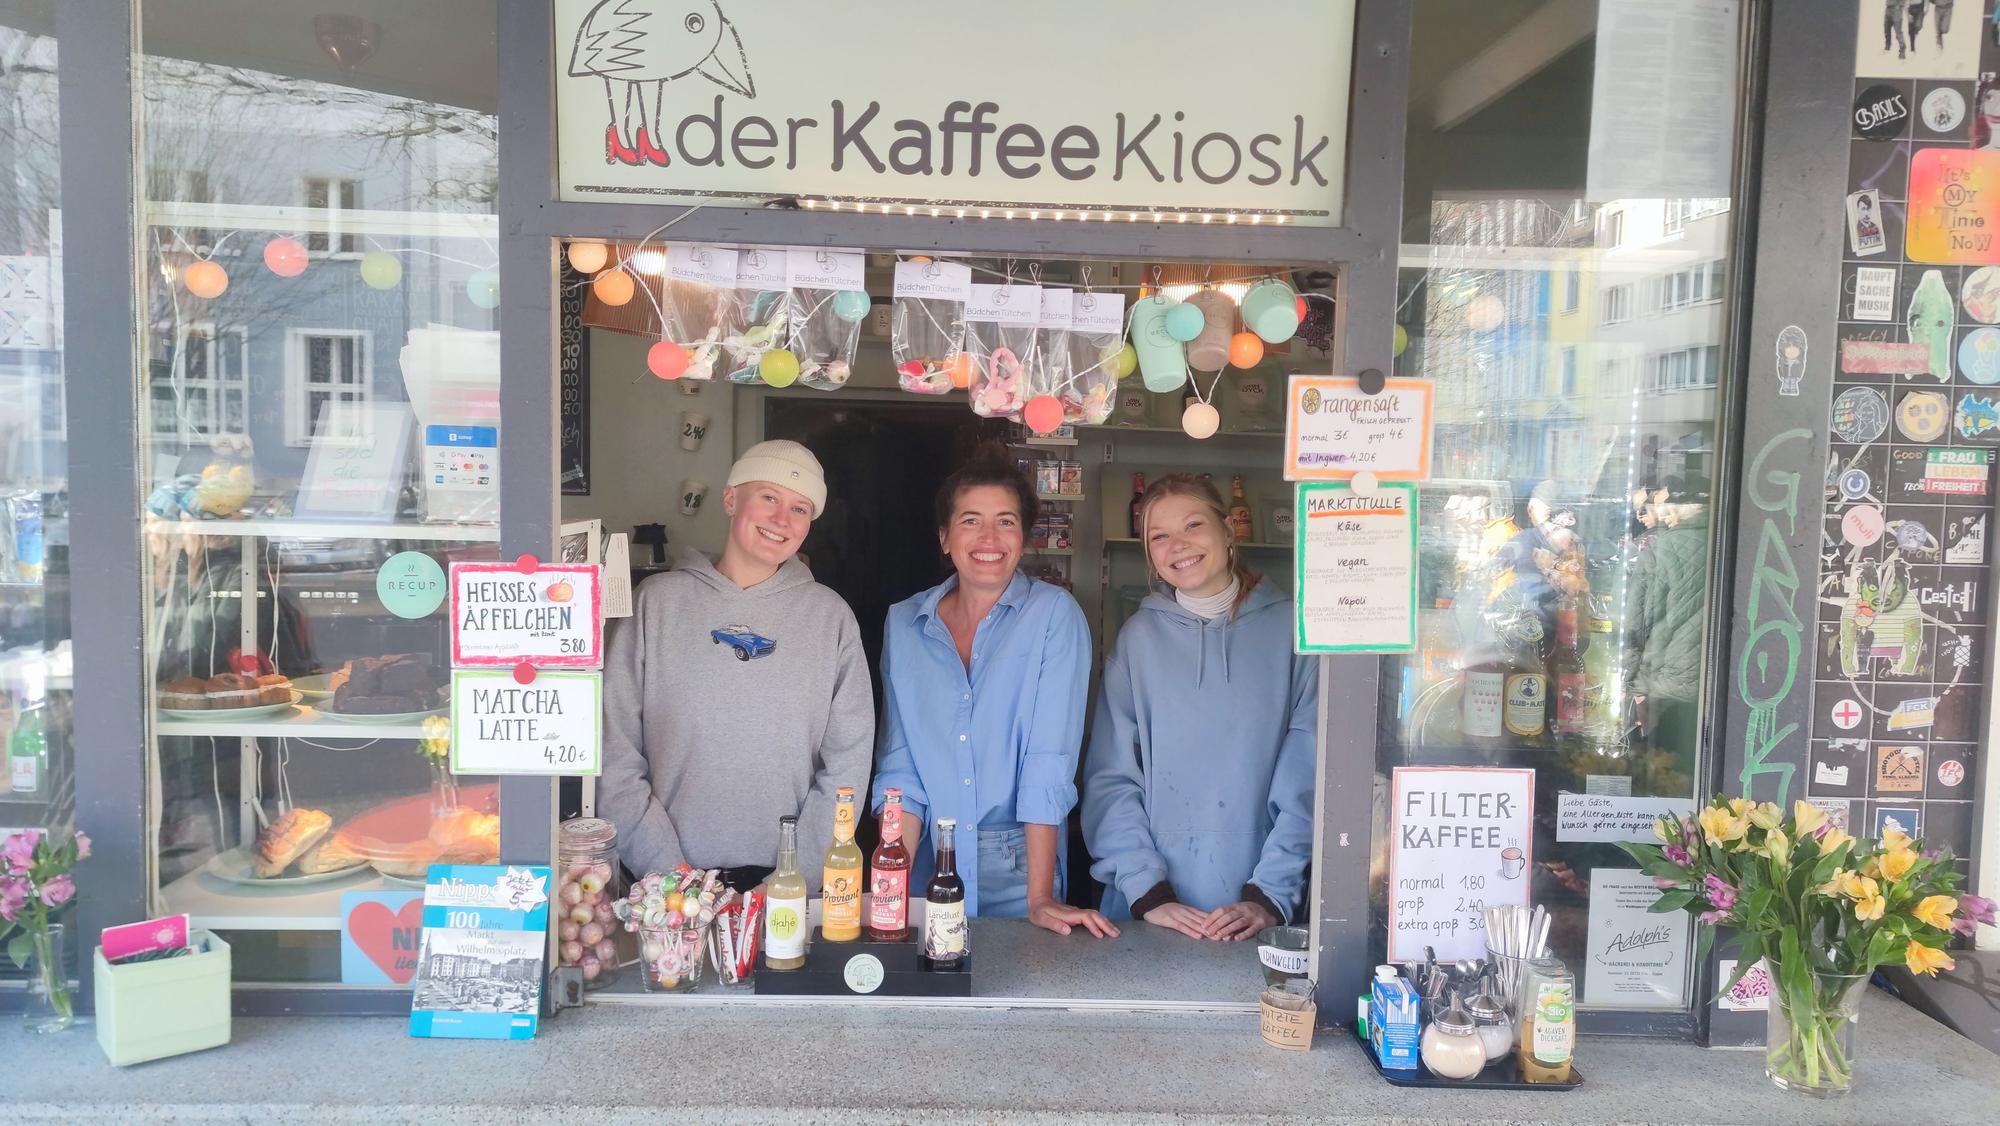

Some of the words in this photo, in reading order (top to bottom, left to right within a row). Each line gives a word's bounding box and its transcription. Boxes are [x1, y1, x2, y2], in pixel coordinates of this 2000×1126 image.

[676, 95, 817, 170] der
[830, 99, 1098, 180] Kaffee
[1112, 112, 1330, 187] Kiosk
[1860, 271, 1892, 281] HAUPT
[1859, 285, 1891, 297] SACHE
[1858, 300, 1890, 311] MUSIK
[1301, 434, 1328, 442] normal
[1298, 453, 1312, 462] mit
[1315, 453, 1346, 466] Ingwer
[1939, 451, 1977, 464] FRAU
[1931, 481, 1981, 492] FREIHEIT
[1308, 496, 1403, 511] MARKTSTULLE
[1337, 521, 1361, 531] Käse
[1337, 557, 1368, 569] vegan
[388, 581, 437, 591] RECUP
[466, 581, 537, 603] HEISSES
[1338, 597, 1366, 608] Napoli
[463, 606, 572, 631] ÄPFELCHEN
[473, 689, 564, 714] MATCHA
[1906, 703, 1929, 711] FCK
[479, 719, 539, 741] LATTE
[1405, 791, 1517, 819] FILTER-
[1563, 798, 1585, 807] Liebe
[1637, 812, 1655, 820] kann
[1561, 820, 1588, 829] Wunsch
[1593, 822, 1617, 832] gerne
[1620, 821, 1653, 834] eingeseh
[1402, 824, 1500, 849] KAFFEE
[1399, 873, 1446, 890] normal
[1459, 875, 1485, 891] 1,80
[824, 888, 859, 903] Proviant
[1398, 897, 1425, 915] groß
[448, 911, 481, 929] 100
[467, 930, 495, 939] Markt
[1398, 918, 1428, 930] extra
[1433, 919, 1459, 937] groß
[391, 927, 423, 951] NI
[1605, 925, 1671, 955] Adolph's
